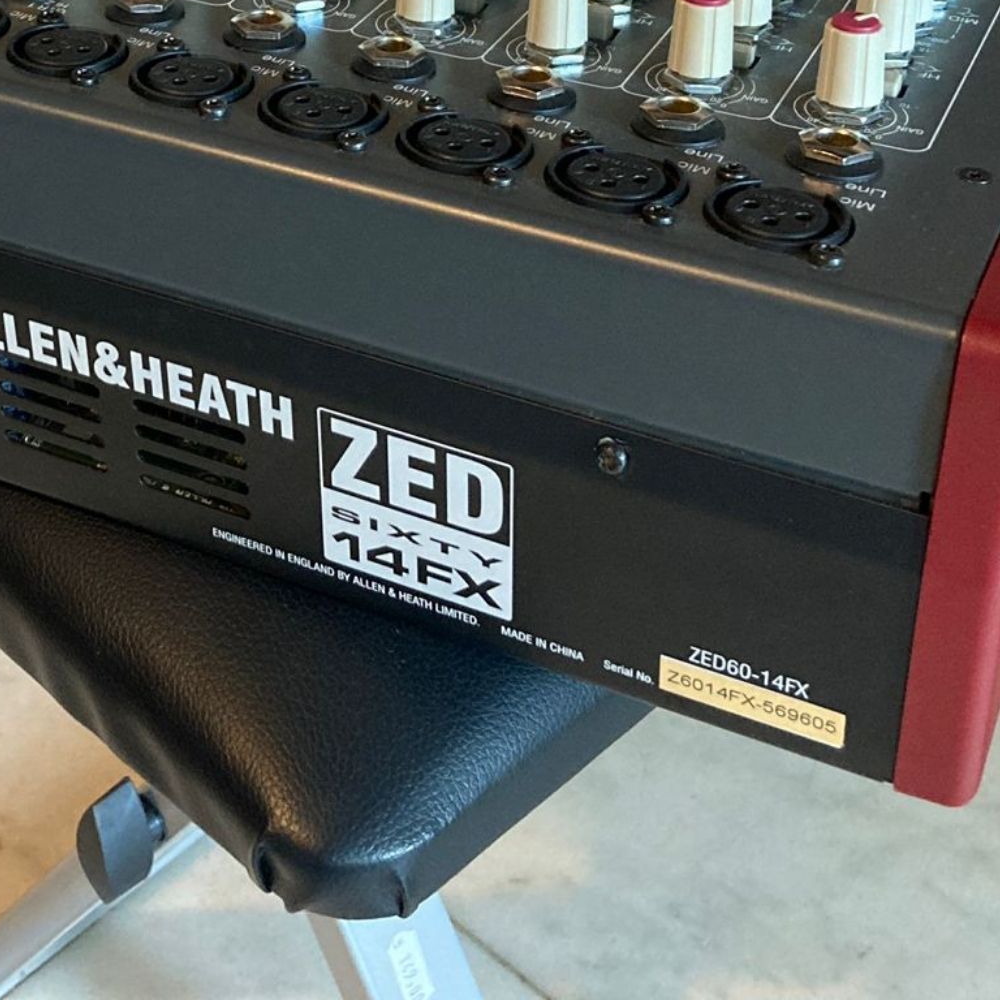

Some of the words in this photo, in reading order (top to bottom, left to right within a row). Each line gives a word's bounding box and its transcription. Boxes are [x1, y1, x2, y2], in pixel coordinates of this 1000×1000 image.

[329, 417, 504, 537] ZED
[331, 505, 503, 568] SIXTY
[212, 527, 272, 556] ENGINEERED
[275, 549, 286, 560] IN
[288, 553, 335, 576] ENGLAND
[337, 569, 351, 582] BY
[352, 576, 386, 594] ALLEN
[388, 587, 396, 598] &
[398, 590, 433, 610] HEATH
[435, 603, 480, 627] LIMITED.
[332, 531, 502, 610] 14FX
[500, 625, 533, 645] MADE
[535, 637, 547, 650] IN
[550, 640, 584, 662] CHINA
[603, 659, 633, 679] Serial
[635, 668, 654, 685] No.
[689, 646, 811, 699] ZED60-14FX
[667, 669, 837, 734] Z6014FX-569605
